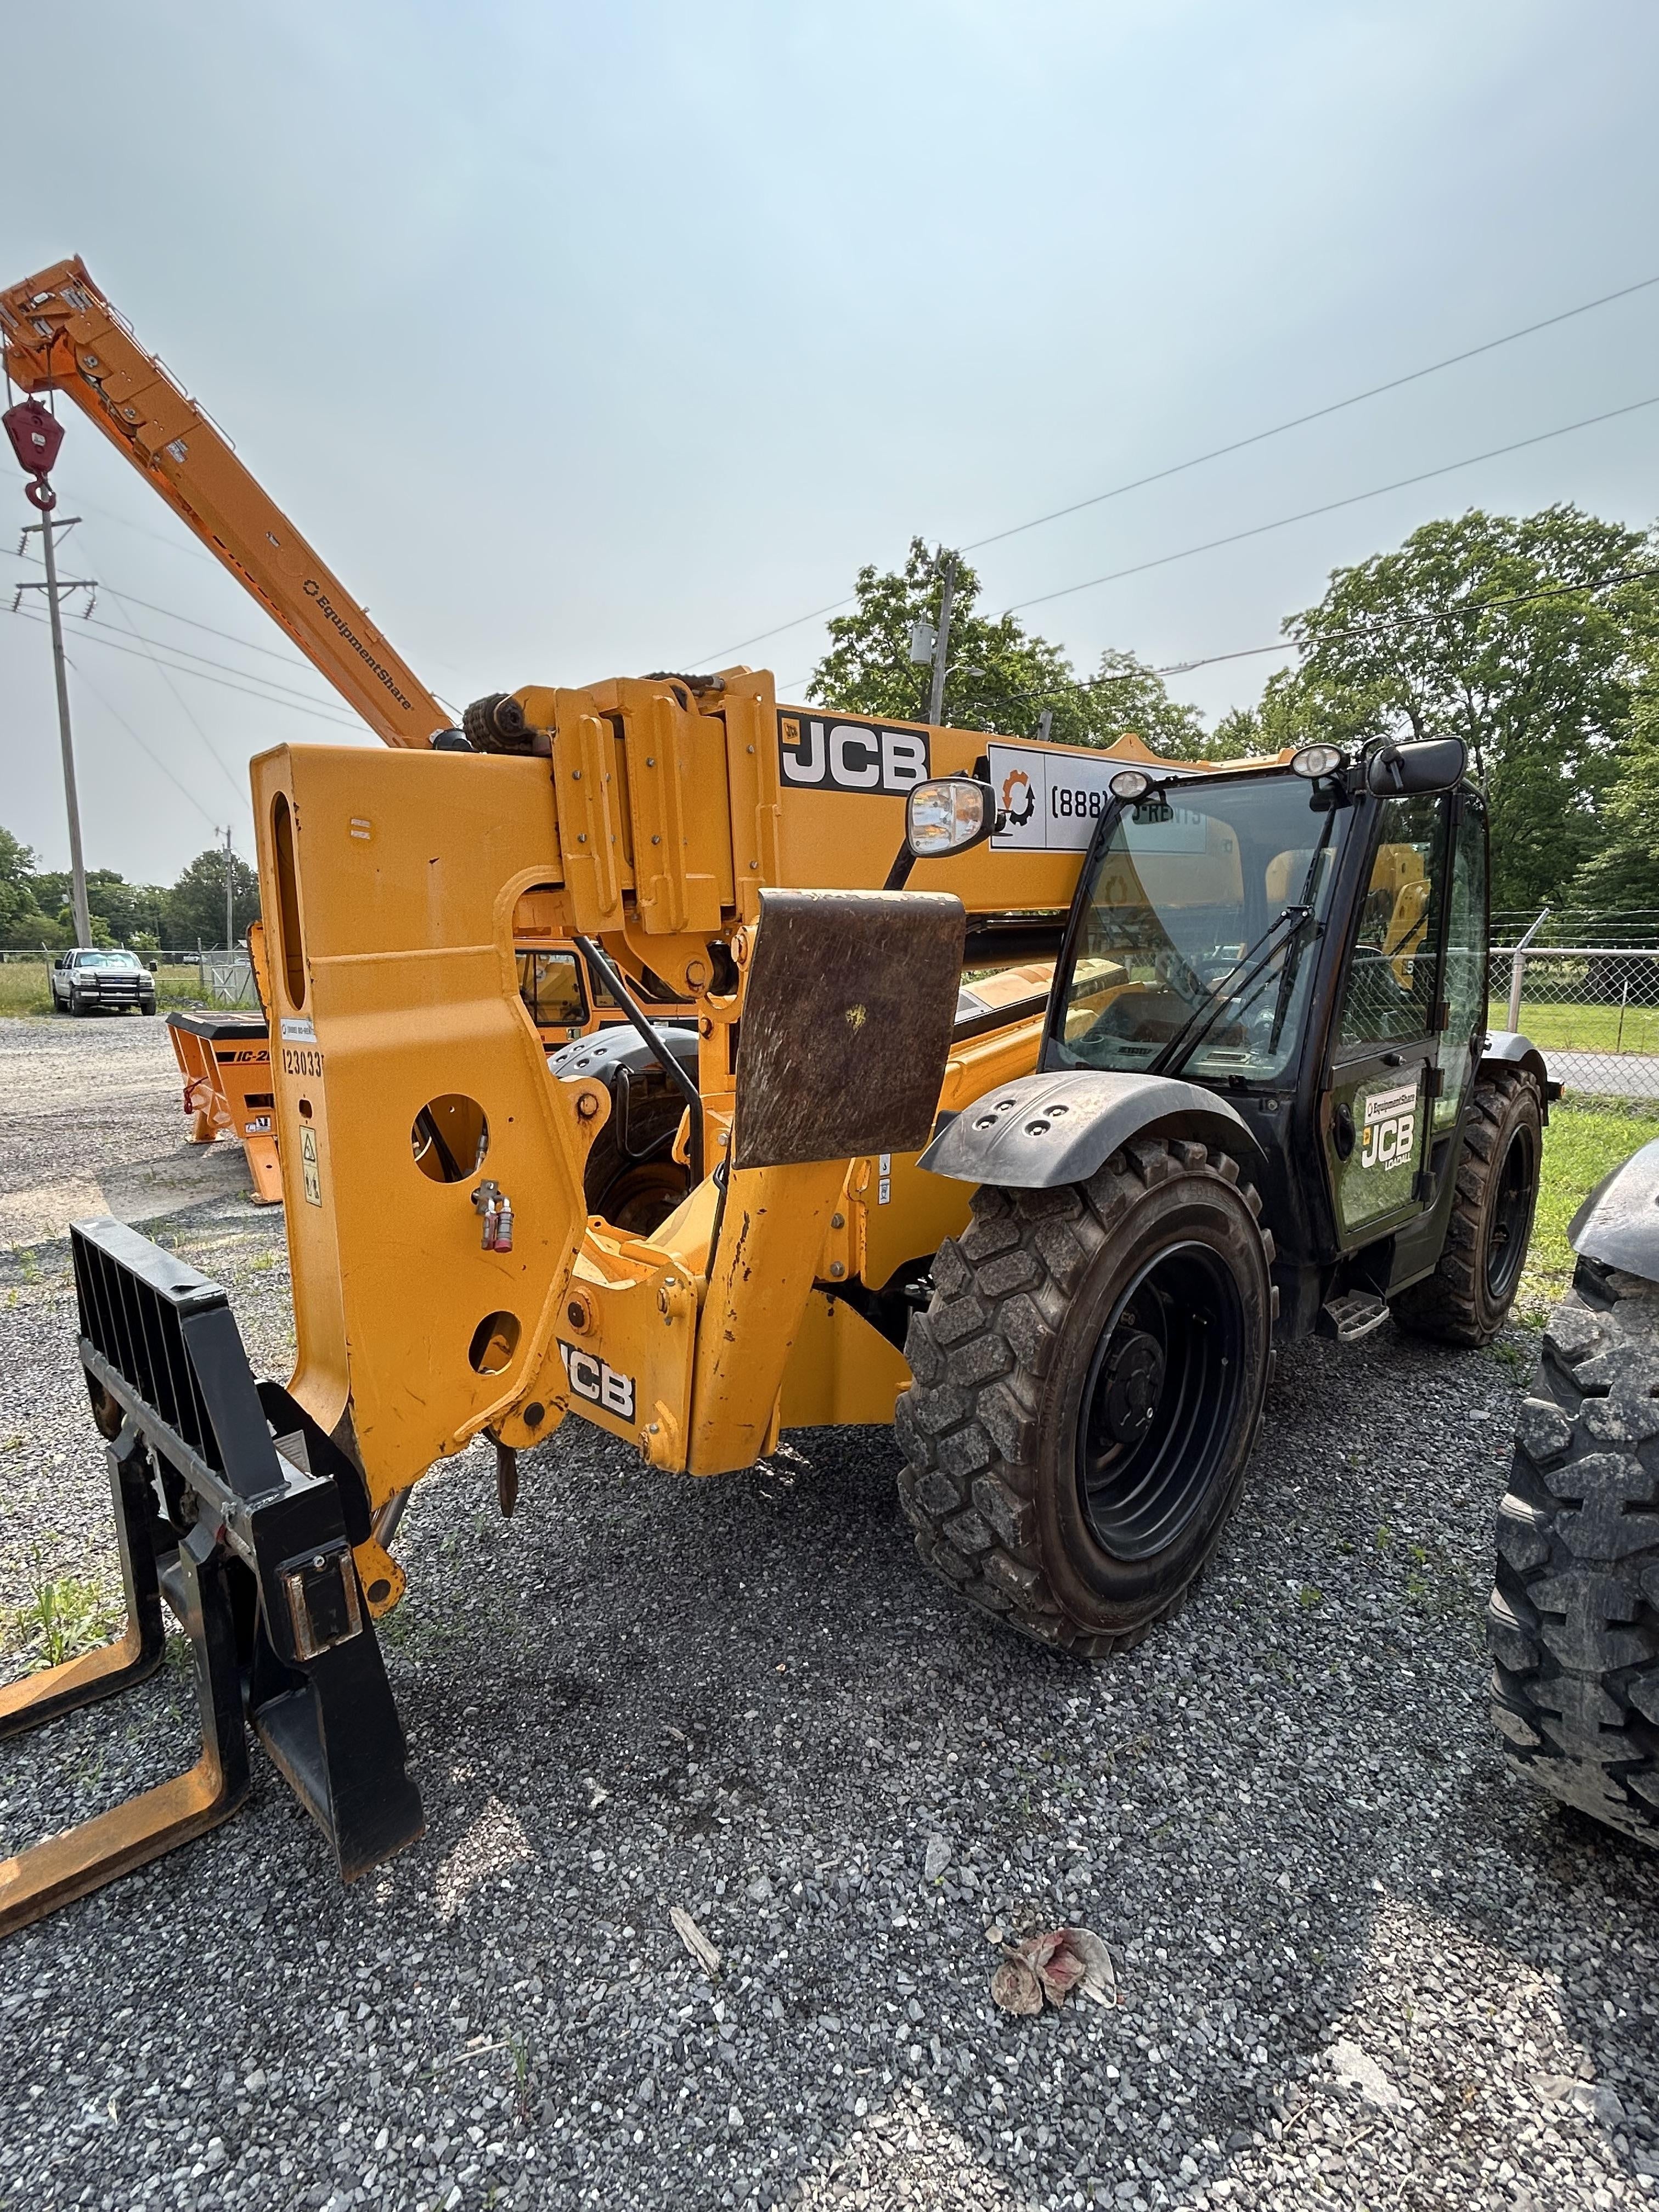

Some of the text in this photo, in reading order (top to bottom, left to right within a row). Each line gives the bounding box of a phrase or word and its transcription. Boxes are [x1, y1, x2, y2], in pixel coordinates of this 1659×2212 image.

[316, 595, 413, 710] EquipmentShare
[782, 721, 928, 791] JCB
[236, 1050, 269, 1062] IC-2
[1362, 1115, 1414, 1169] JCB
